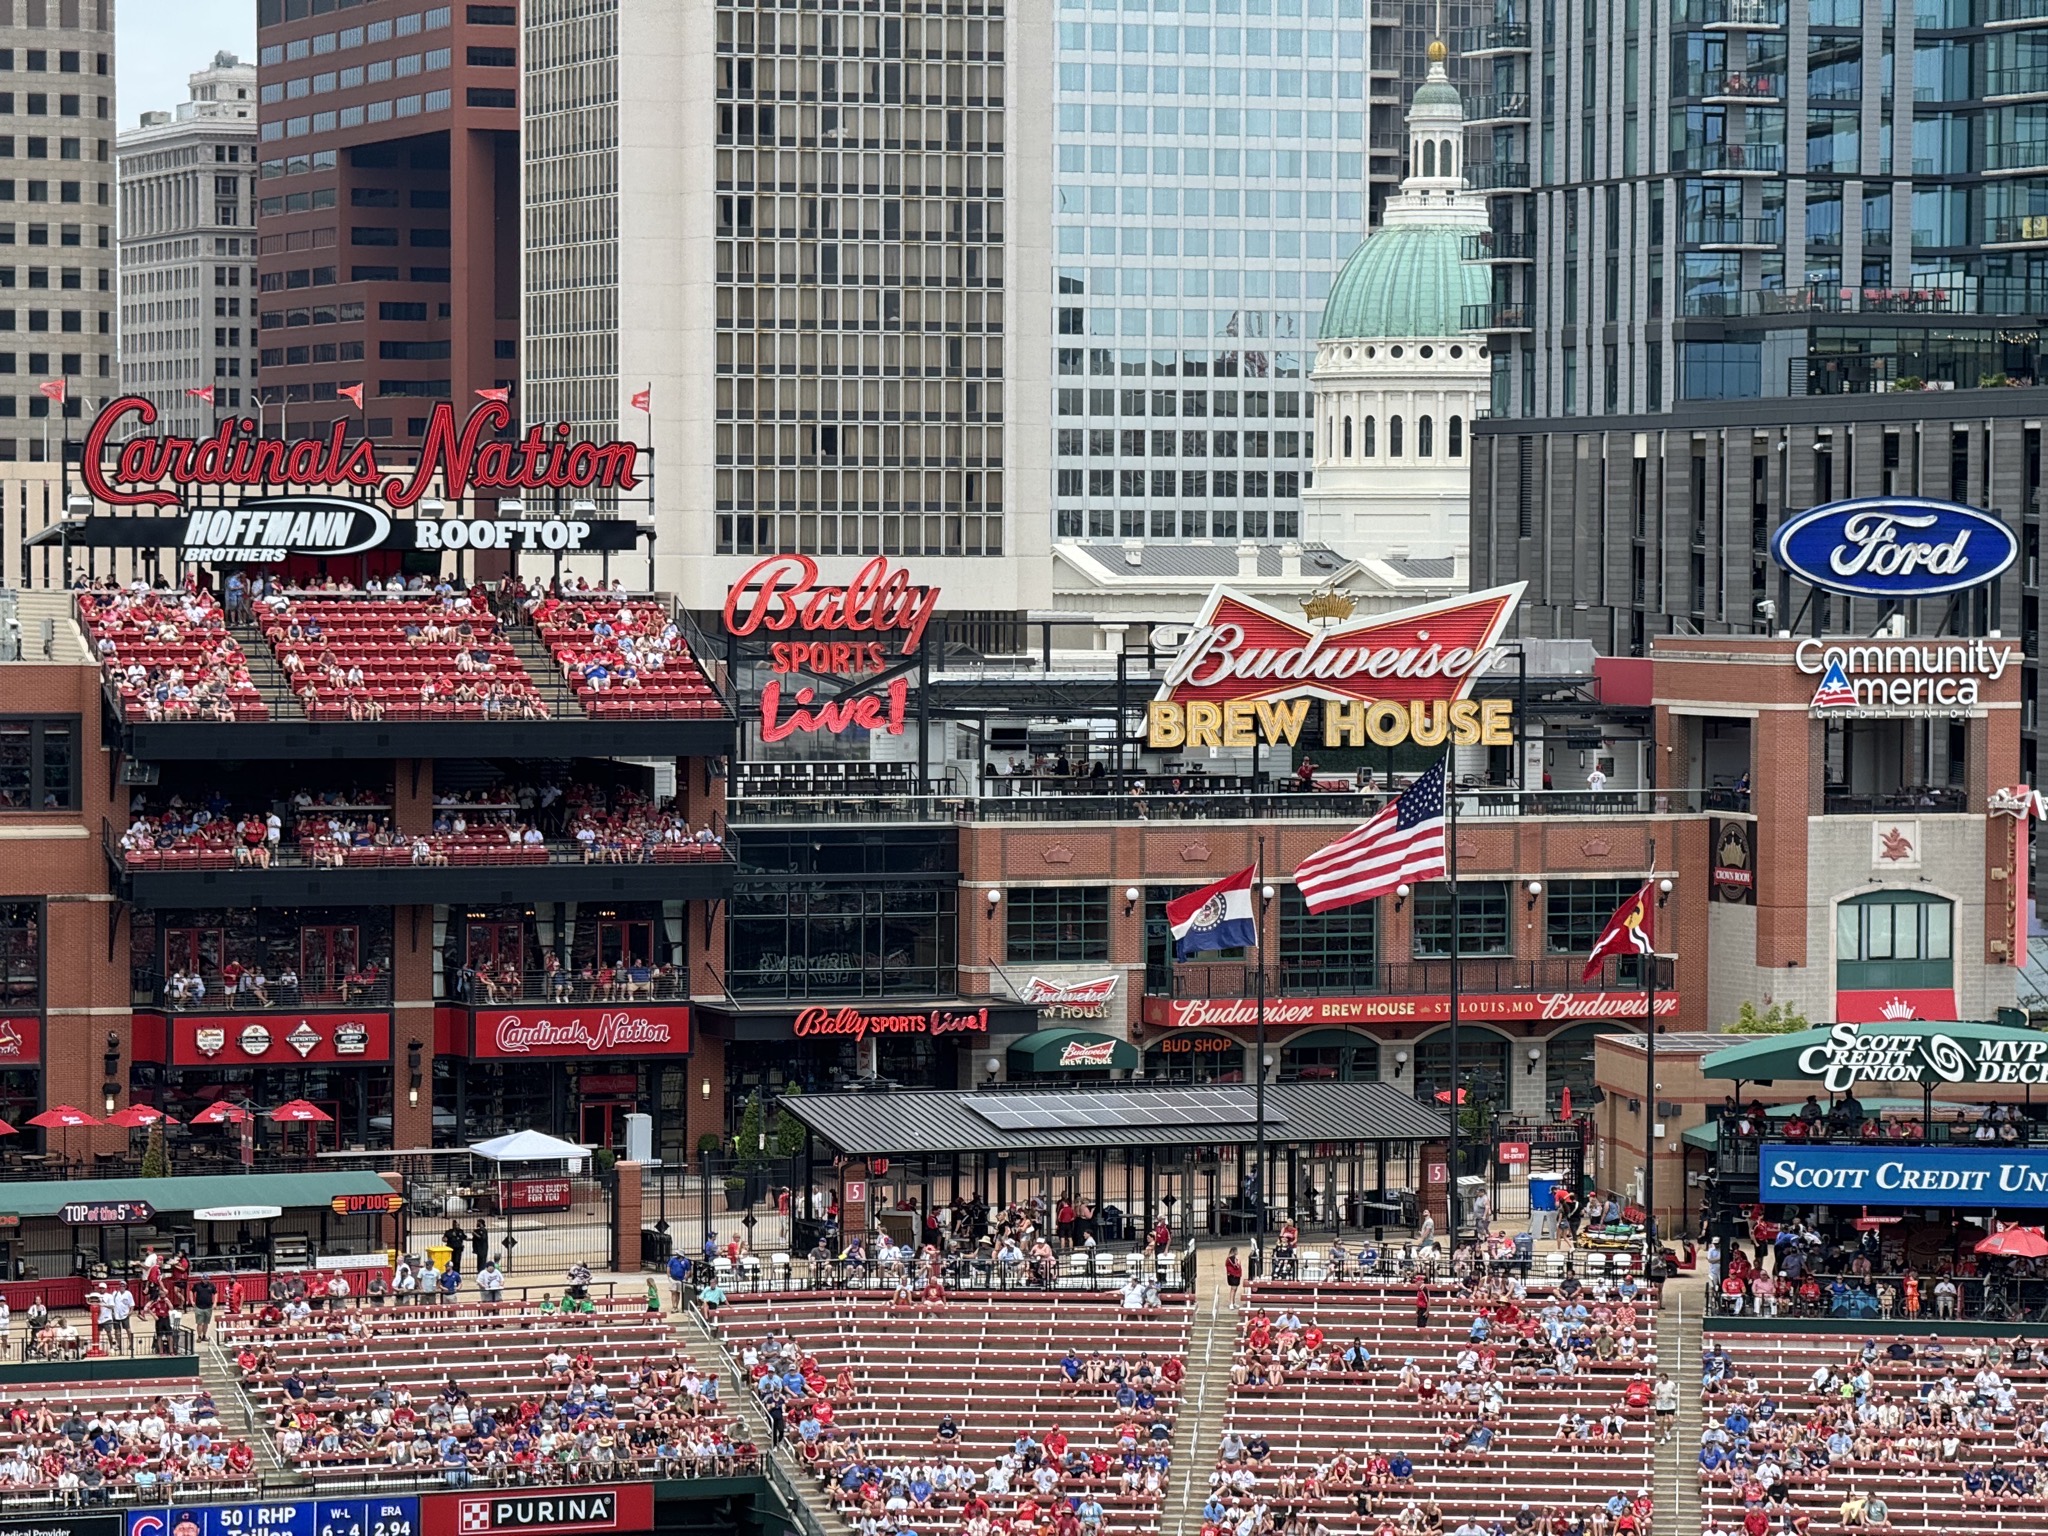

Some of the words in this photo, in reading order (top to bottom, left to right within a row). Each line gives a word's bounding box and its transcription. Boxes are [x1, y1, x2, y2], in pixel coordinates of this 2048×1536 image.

[82, 396, 386, 506] Cardinals
[383, 400, 642, 507] Nation
[184, 508, 357, 548] HOFFMANN
[414, 520, 591, 550] ROOFTOP
[184, 547, 287, 562] BROTHERS
[1830, 512, 1972, 576] Ford
[723, 553, 941, 655] Bally
[770, 641, 887, 674] SPORTS
[1149, 621, 1510, 688] Budweiser
[1796, 638, 2011, 680] Community
[760, 677, 907, 743] Live!
[1816, 709, 1892, 719] CREDIT
[1909, 709, 1973, 719] UNION
[1147, 699, 1311, 748] BREW
[1322, 699, 1514, 748] HOUSE
[1715, 870, 1734, 880] CROWN
[1735, 871, 1750, 882] ROOM
[1018, 985, 1115, 1003] Budweiser
[1061, 1006, 1113, 1018] HOUSE
[1172, 998, 1314, 1027] Budweiser
[1322, 1003, 1363, 1017] BREW
[1366, 1002, 1415, 1016] HOUSE
[1537, 992, 1676, 1020] Budweiser
[496, 1015, 592, 1052] Cardinals
[587, 1012, 671, 1051] Nation
[794, 1006, 870, 1042] Bally
[870, 1015, 927, 1033] SPORTS
[930, 1007, 988, 1035] Live!
[1162, 1039, 1191, 1053] BUD
[1194, 1038, 1232, 1052] SHOP
[1827, 1023, 1922, 1051] SCOTT
[1060, 1058, 1083, 1066] BREW
[1085, 1057, 1112, 1065] HOUSE
[1061, 1046, 1114, 1057] Budweiser
[1798, 1045, 1914, 1075] CREDIT
[1976, 1040, 2048, 1062] MVP
[1823, 1064, 1925, 1092] UNION
[1434, 1166, 1441, 1181] 5
[1770, 1160, 1869, 1188] SCOTT
[1875, 1161, 1990, 1191] CREDIT
[1999, 1164, 2048, 1192] UN
[526, 1185, 544, 1195] THIS
[527, 1194, 544, 1203] FOR
[545, 1192, 560, 1202] YOU
[852, 1184, 860, 1198] 5
[65, 1205, 88, 1222] TOP
[88, 1207, 99, 1222] of
[100, 1206, 117, 1221] the
[345, 1196, 366, 1211] TOP
[367, 1194, 389, 1210] DOG
[220, 1509, 243, 1526] 50
[258, 1507, 297, 1525] RHP
[330, 1508, 351, 1519] W-L
[381, 1505, 402, 1516] ERA
[497, 1499, 608, 1524] PURINA
[322, 1524, 333, 1536] 6
[349, 1523, 360, 1536] 4
[374, 1521, 411, 1536] 2.94
